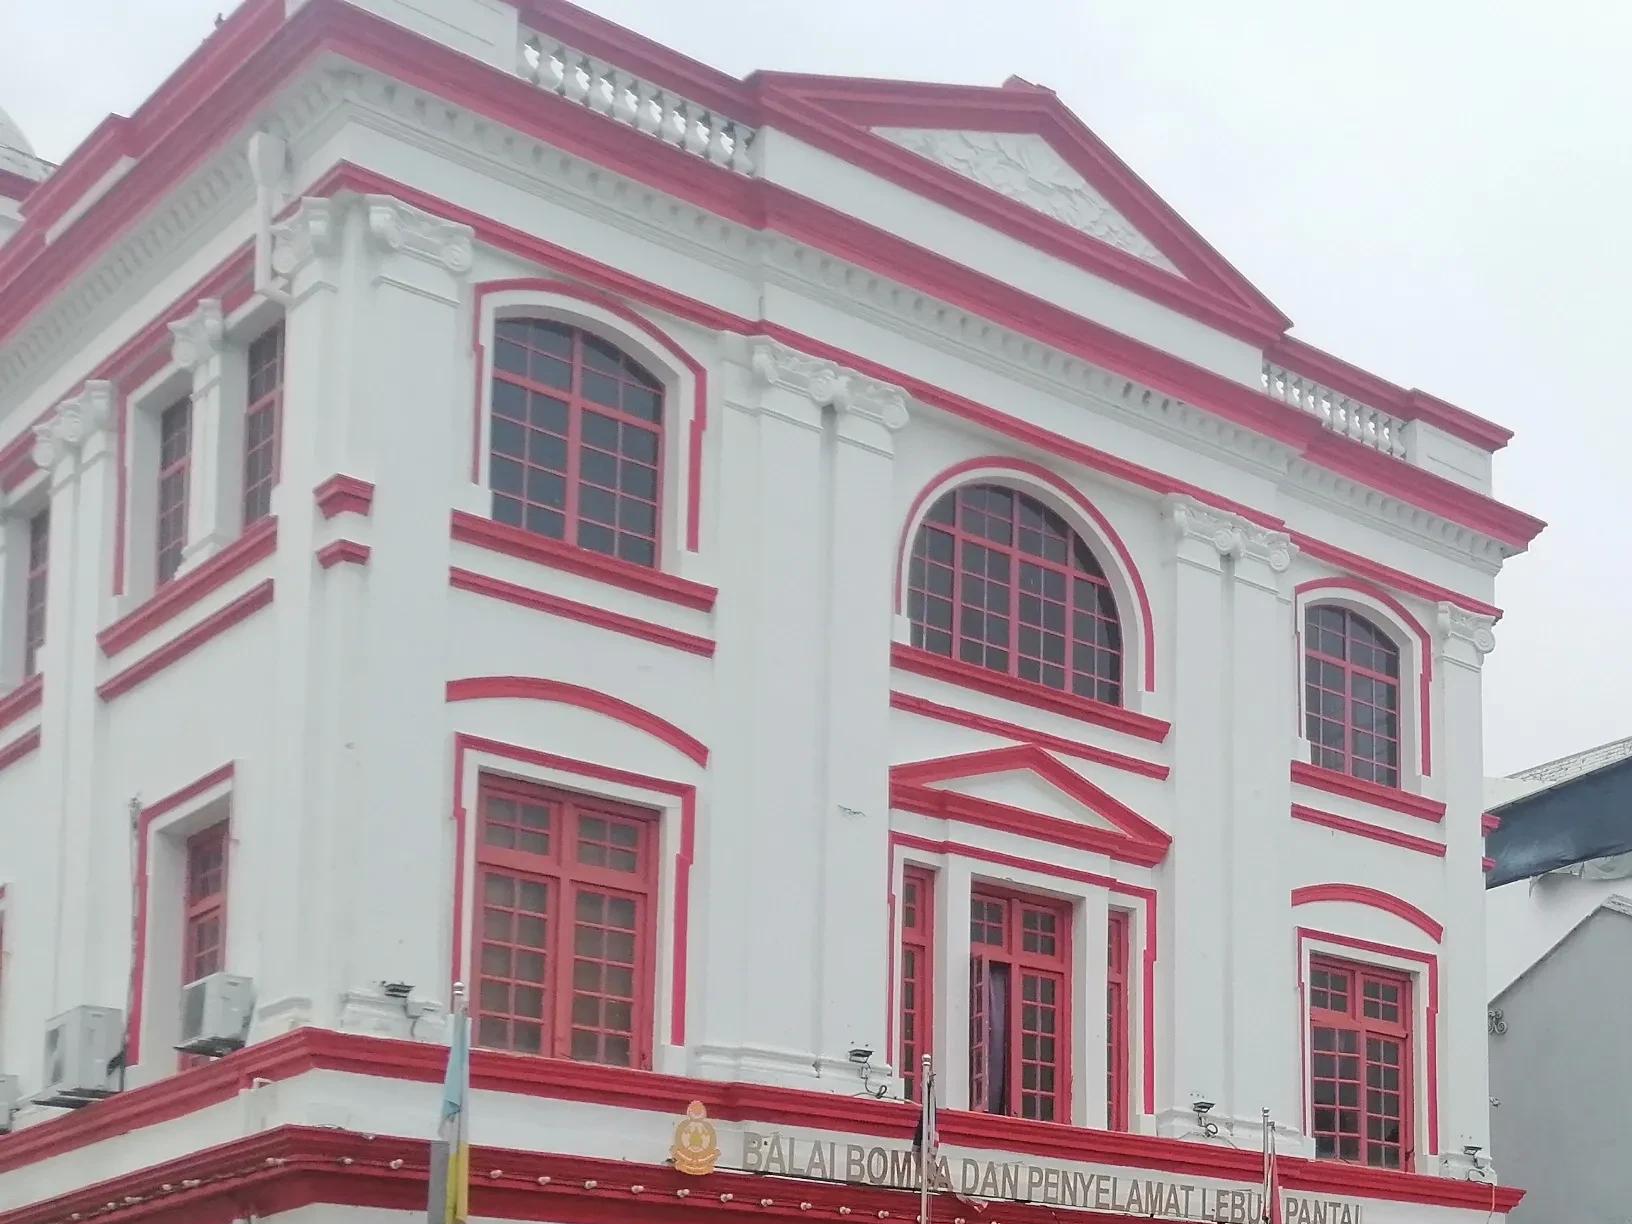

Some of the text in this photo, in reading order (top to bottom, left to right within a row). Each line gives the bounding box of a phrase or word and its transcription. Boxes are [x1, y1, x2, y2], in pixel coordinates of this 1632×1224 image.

[742, 1132, 835, 1175] BALAI
[962, 1158, 1018, 1199] DAN
[1027, 1167, 1195, 1218] PENYELAMAT
[1201, 1188, 1268, 1224] LEBU
